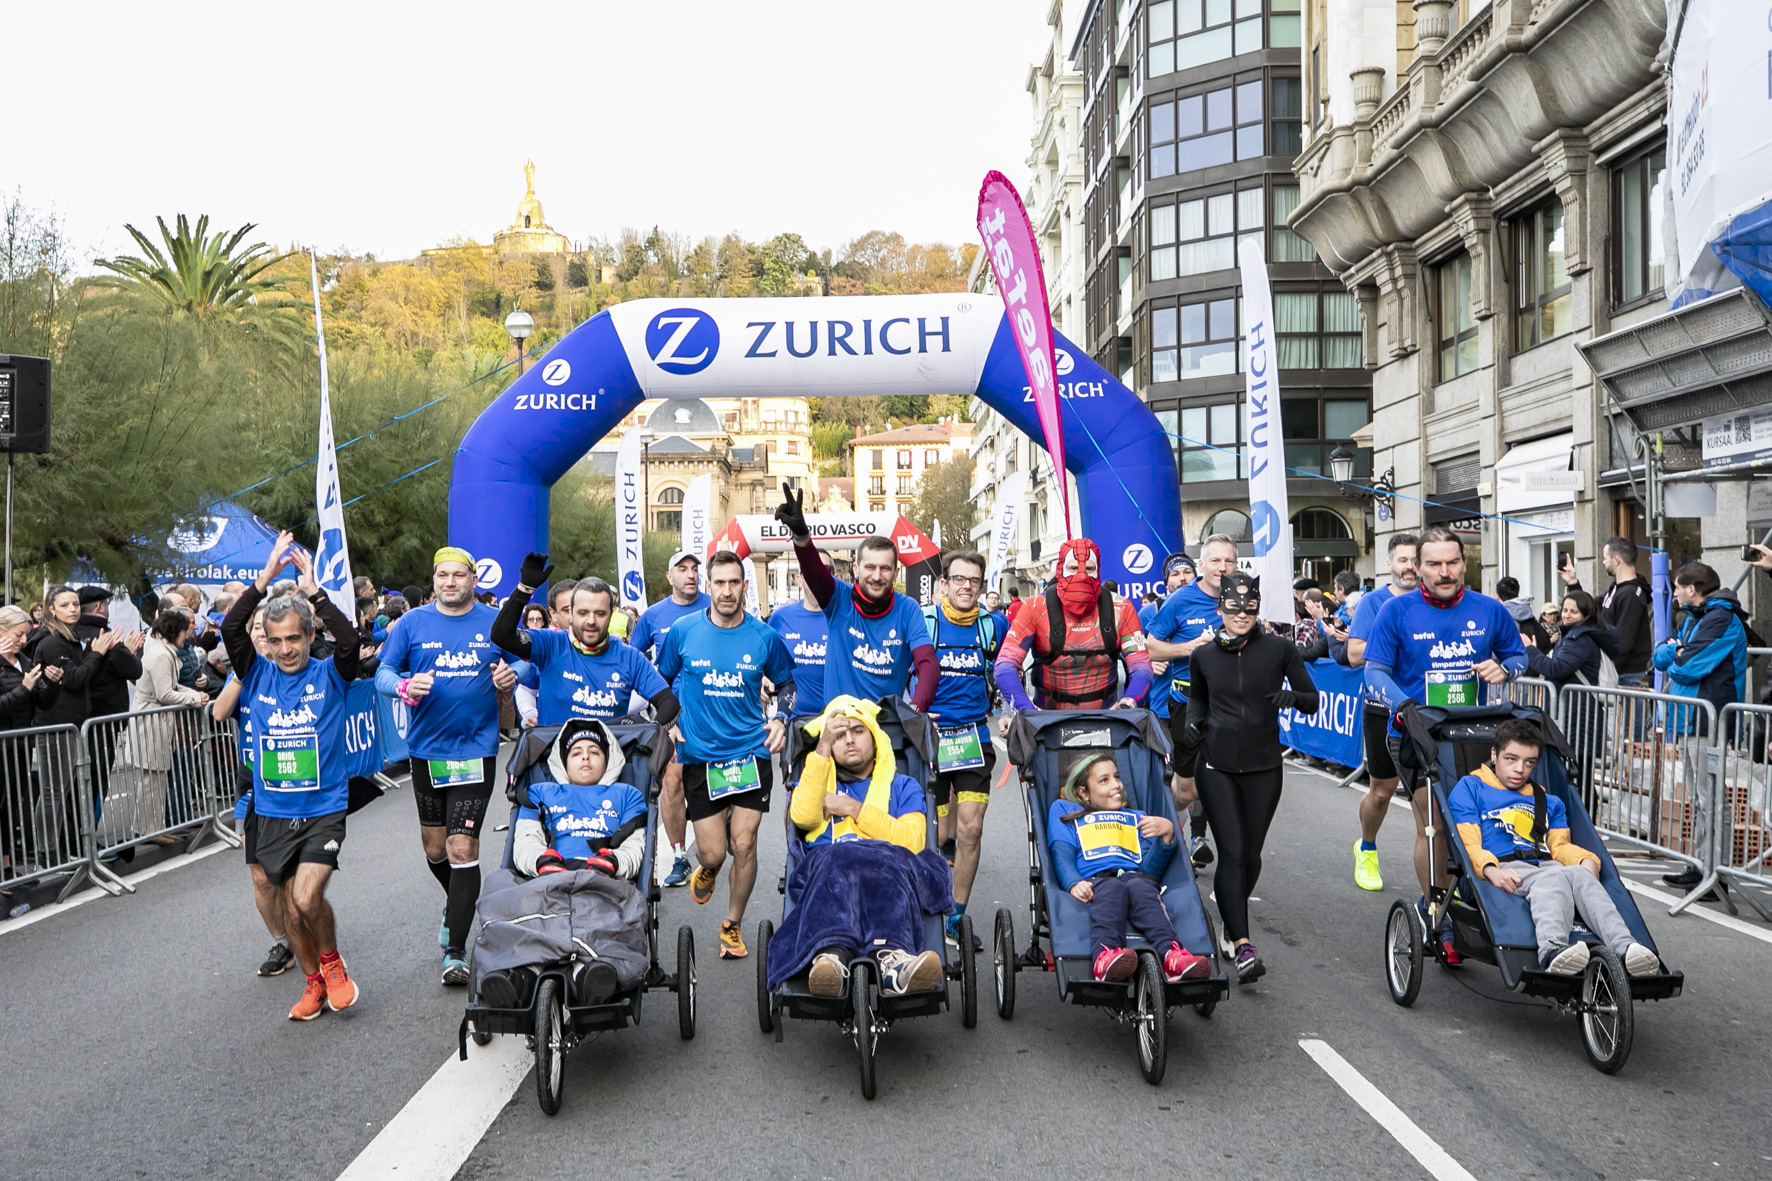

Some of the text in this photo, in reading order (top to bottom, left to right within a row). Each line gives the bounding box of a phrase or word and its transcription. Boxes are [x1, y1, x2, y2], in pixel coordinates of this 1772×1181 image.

[744, 315, 952, 359] ZURICH
[1022, 381, 1105, 403] ZRICH
[513, 393, 597, 411] ZURICH
[623, 472, 638, 560] ZURICH
[692, 509, 704, 556] URICH
[760, 525, 777, 537] EL
[829, 522, 876, 535] VASCO
[897, 534, 919, 549] DV
[919, 574, 930, 608] VASCO
[1461, 629, 1485, 637] ZURICH
[435, 669, 479, 678] #imparables
[1447, 674, 1472, 682] ZURICH
[703, 689, 745, 698] #imparables
[1448, 683, 1463, 693] JOSE
[1447, 693, 1466, 705] 2566
[277, 739, 308, 749] ZURICH
[277, 751, 296, 762] ORIOL
[1098, 814, 1127, 823] ZURICH
[1094, 823, 1123, 832] BARBARA
